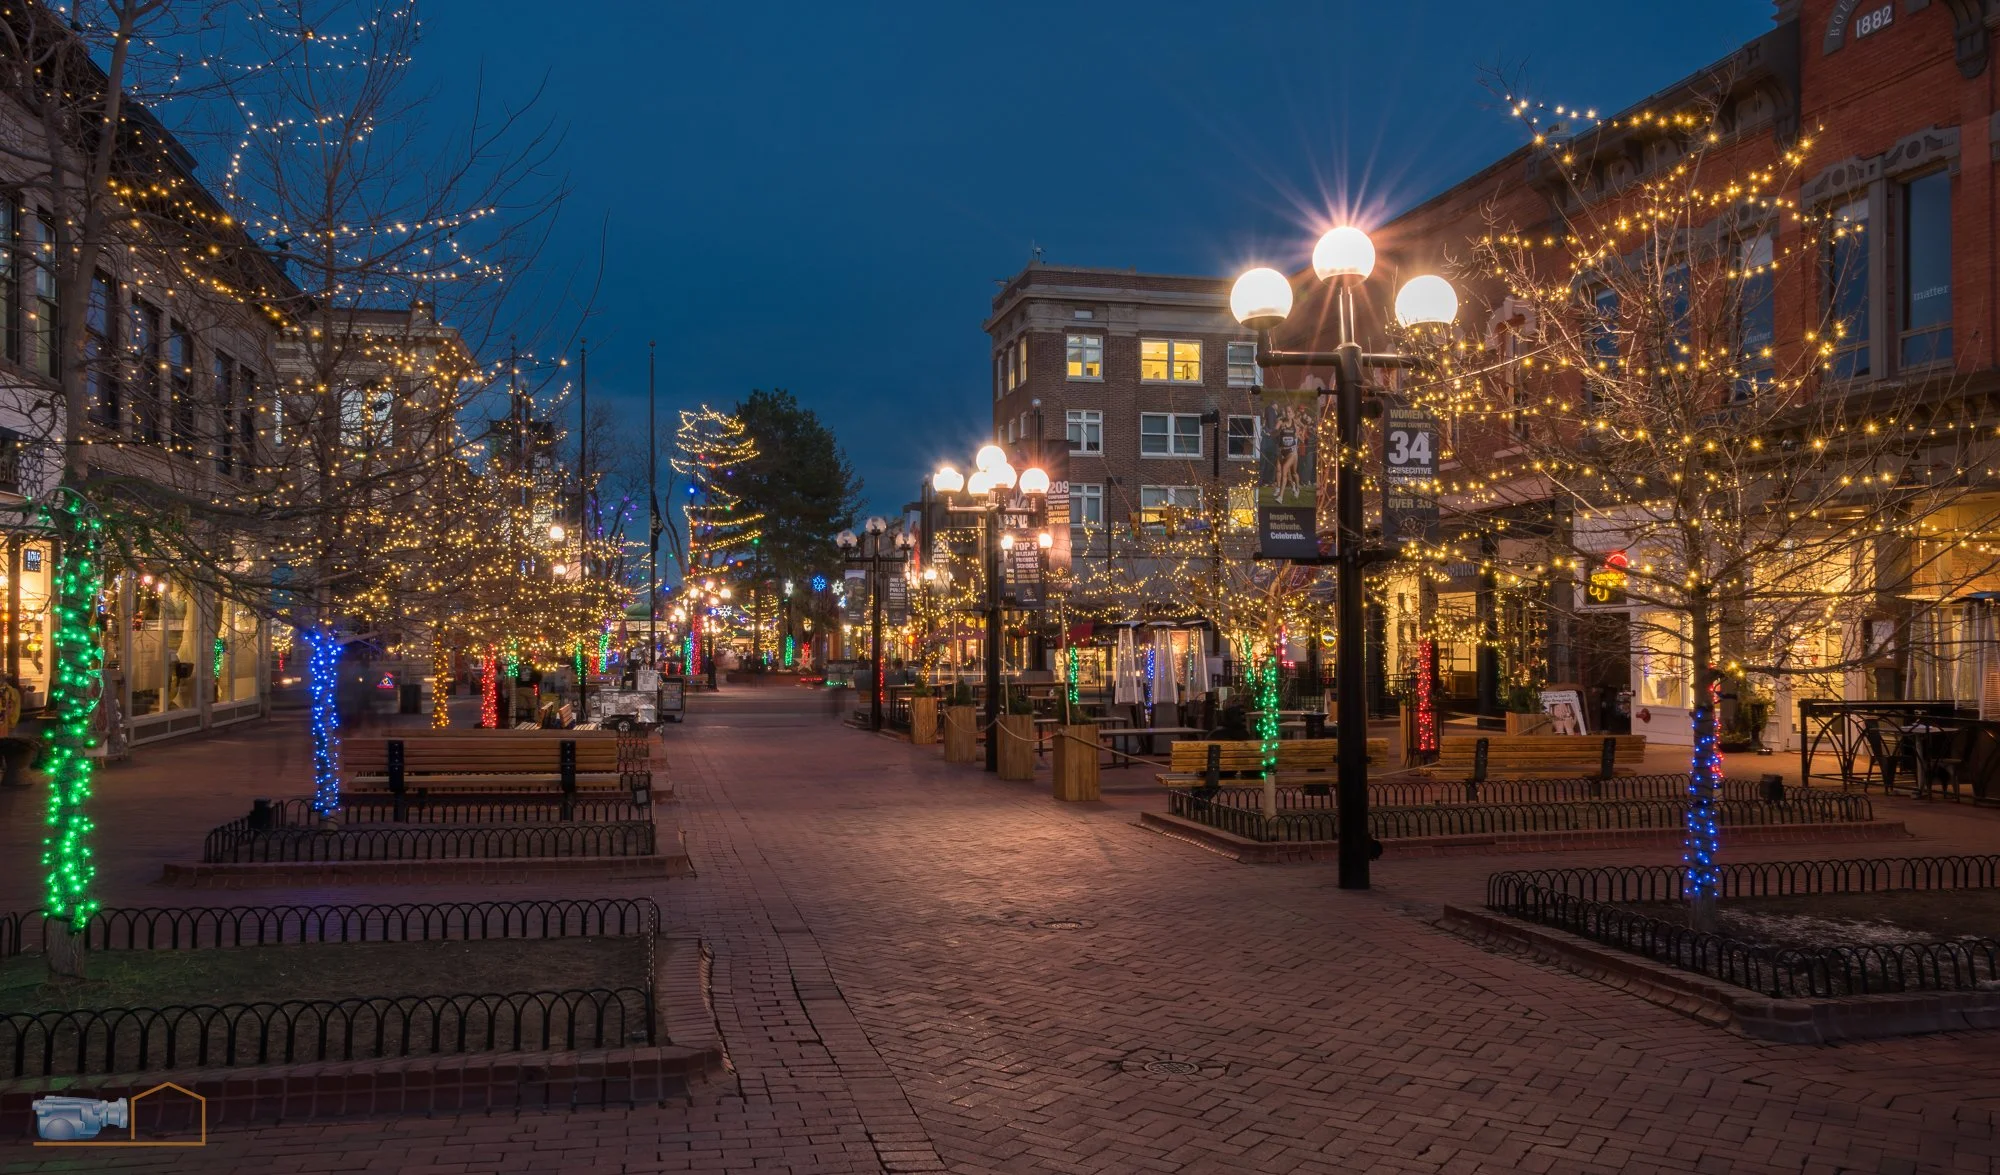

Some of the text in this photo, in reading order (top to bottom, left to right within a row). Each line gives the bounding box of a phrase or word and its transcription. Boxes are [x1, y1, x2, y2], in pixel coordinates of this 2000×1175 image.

[1856, 5, 1893, 39] 1882
[1913, 285, 1950, 301] matter
[1390, 409, 1432, 420] WOMEN'S
[1388, 430, 1432, 465] 34
[1048, 481, 1070, 494] 209
[1388, 498, 1414, 509] OVER
[1269, 513, 1296, 522] Inspire.
[1270, 522, 1303, 531] Motivate.
[1270, 532, 1306, 540] Celebrate.
[1015, 541, 1037, 551] TOP 3
